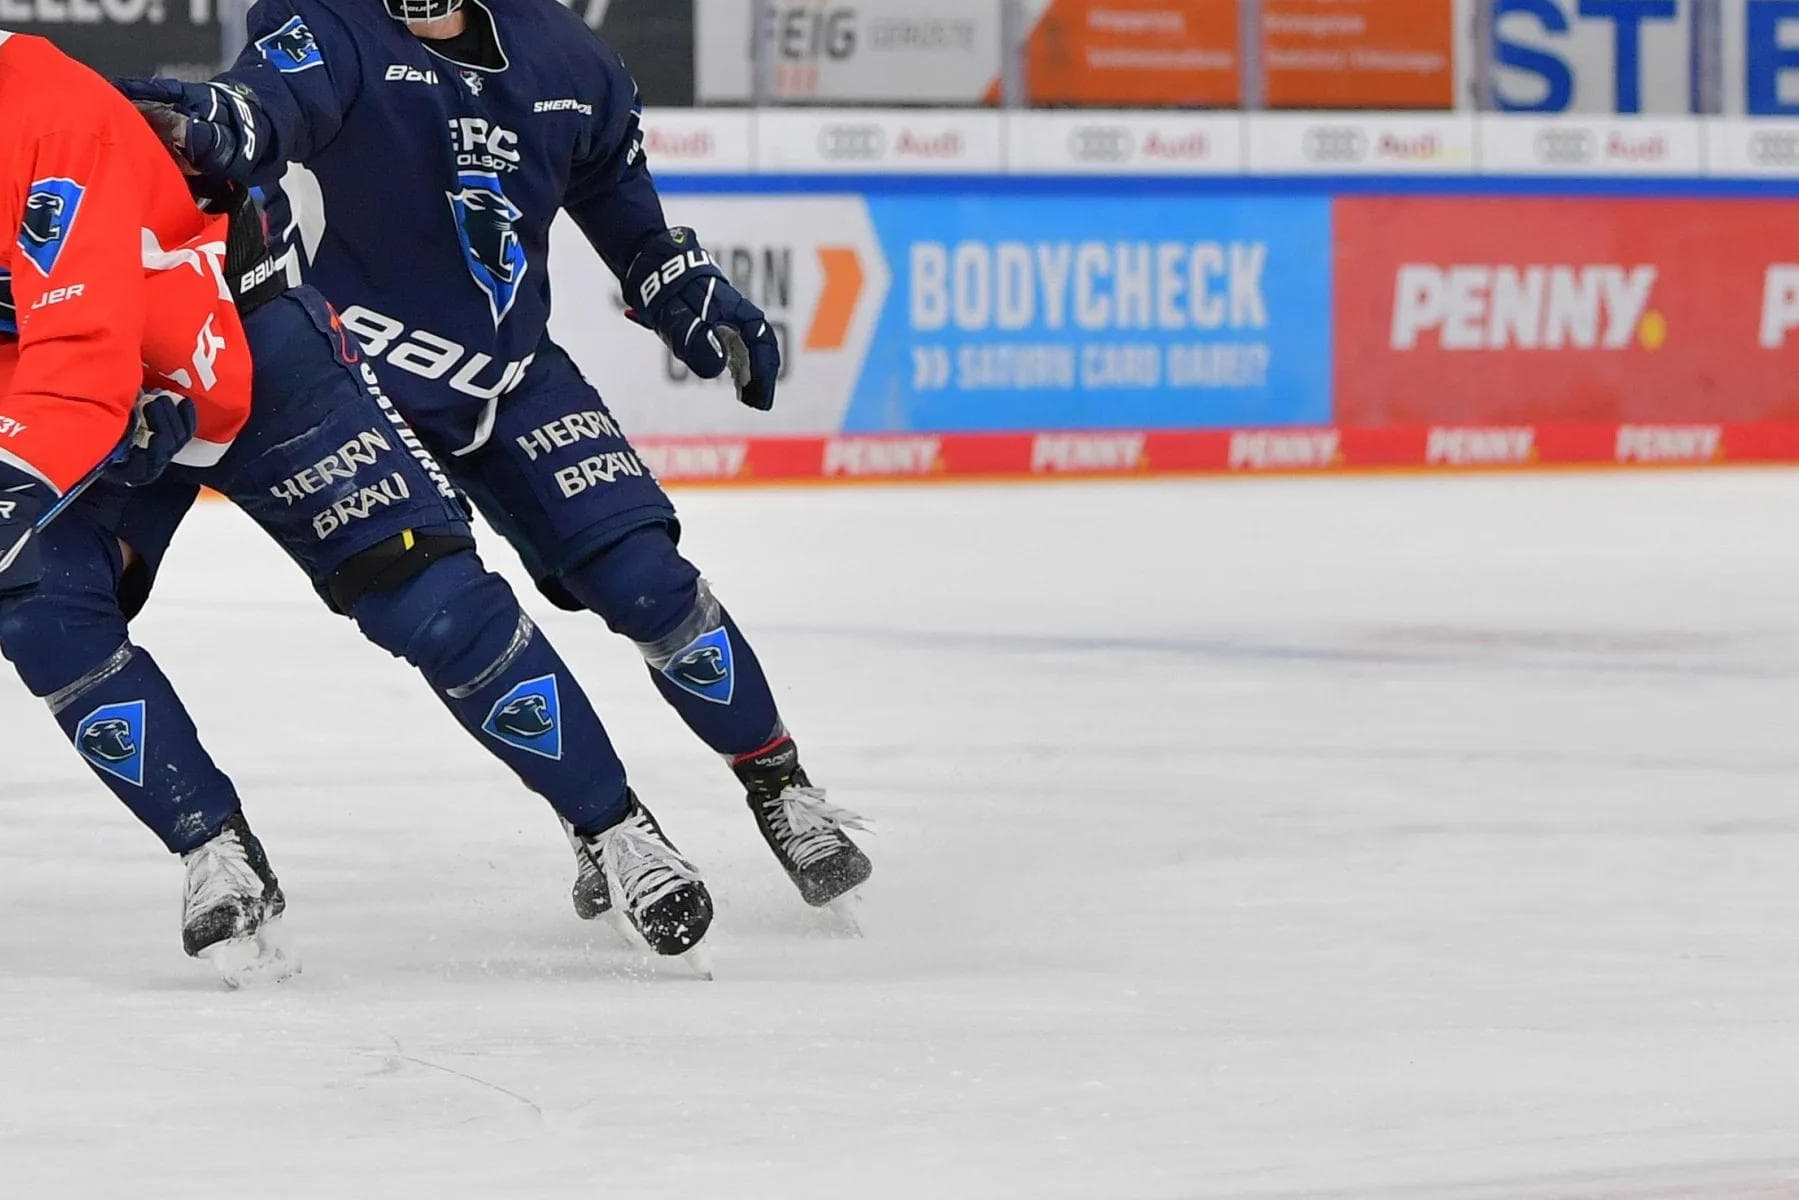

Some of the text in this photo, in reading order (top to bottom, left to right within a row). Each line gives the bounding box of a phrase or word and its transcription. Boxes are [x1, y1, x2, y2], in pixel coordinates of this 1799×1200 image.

[896, 126, 965, 157] Audi
[909, 240, 1268, 330] BODYCHECK
[270, 427, 392, 506] HERRN
[553, 451, 643, 500] BRÄU
[311, 472, 411, 541] BRÄU
